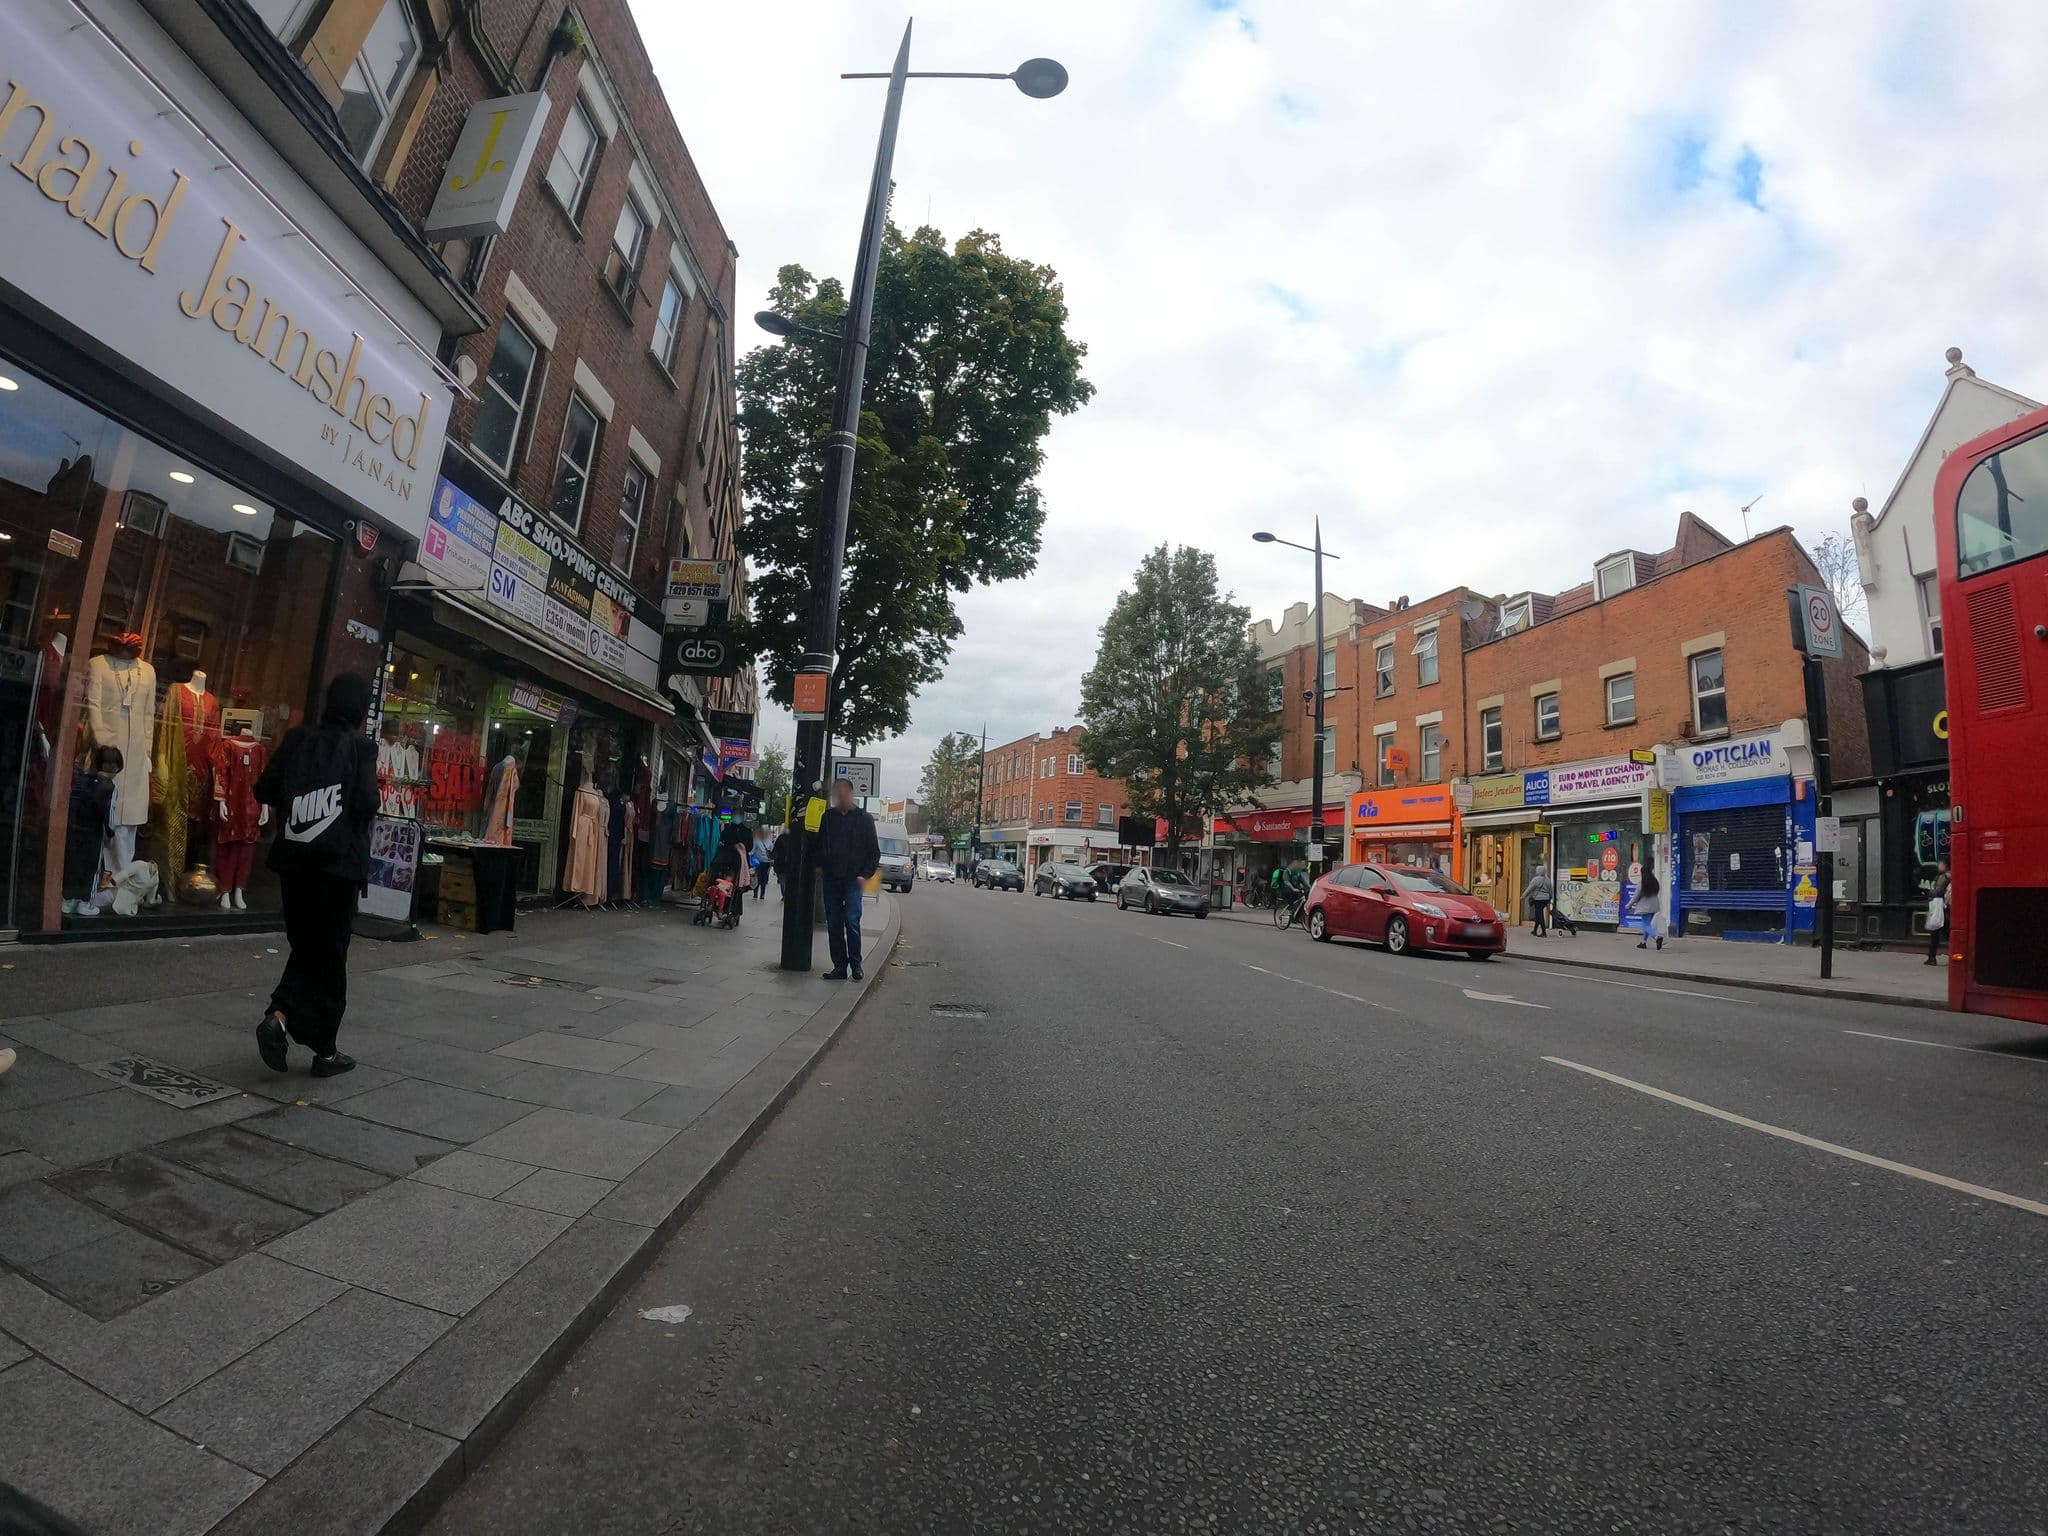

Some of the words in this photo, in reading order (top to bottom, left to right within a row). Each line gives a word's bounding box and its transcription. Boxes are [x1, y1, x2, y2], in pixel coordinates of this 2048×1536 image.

[178, 217, 431, 471] Jamshed
[321, 424, 339, 446] BY
[342, 433, 412, 501] JANAN
[498, 497, 533, 535] ABC
[532, 521, 596, 583] SHOPPING
[596, 570, 637, 613] CENTRE
[492, 568, 516, 603] SM
[1812, 604, 1827, 622] 20
[685, 640, 717, 659] abc
[1813, 633, 1834, 648] ZONE
[512, 688, 540, 711] TAILOR
[1692, 740, 1771, 767] OPTICIAN
[1558, 772, 1576, 782] EURO
[1577, 769, 1603, 780] MONEY
[1604, 763, 1645, 776] EXCHANGE
[1695, 764, 1719, 774] THOMAS
[1759, 757, 1771, 766] LTD
[1525, 779, 1548, 791] ALICO
[1558, 783, 1574, 792] AND
[1574, 779, 1600, 790] TRAVEL
[1601, 775, 1631, 787] AGENCY
[1632, 773, 1645, 783] LTD
[1926, 782, 1950, 796] SLO
[290, 783, 342, 826] NIKE
[1358, 800, 1379, 818] Ria
[1261, 820, 1291, 831] Santander
[1603, 851, 1617, 862] ria
